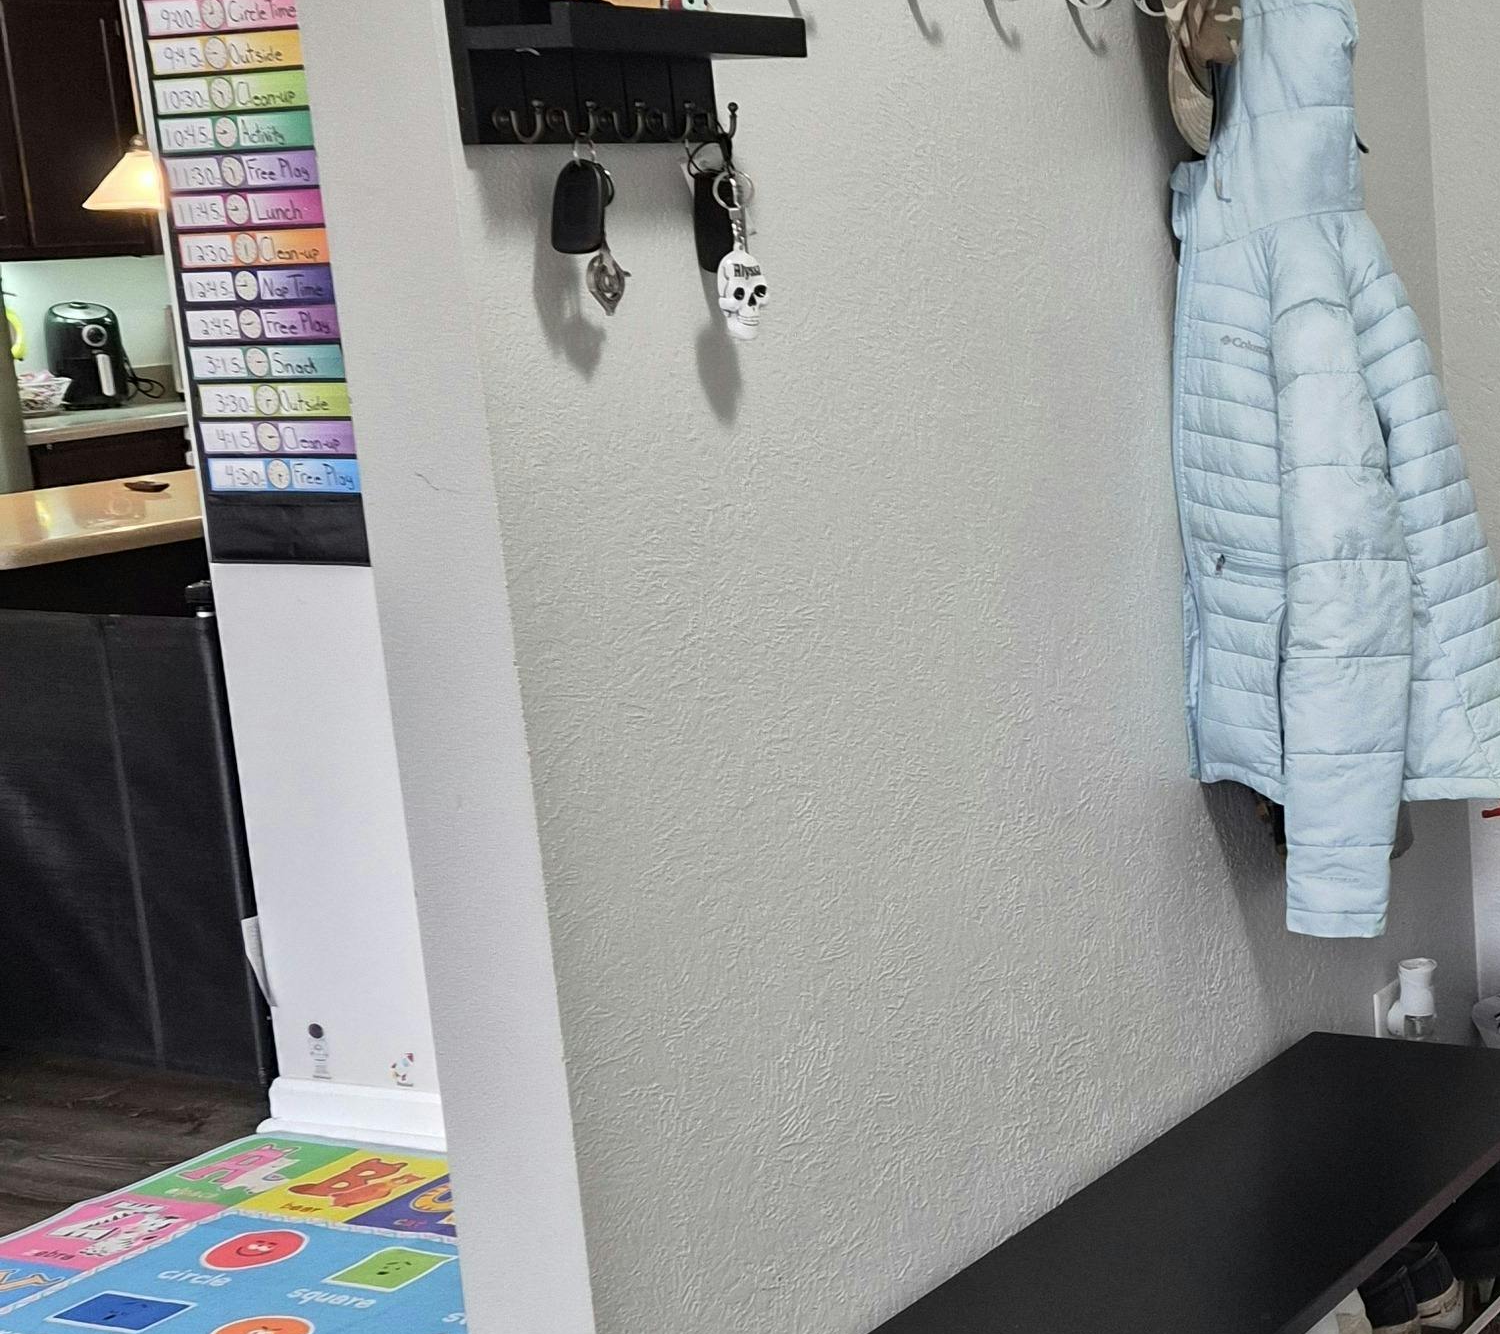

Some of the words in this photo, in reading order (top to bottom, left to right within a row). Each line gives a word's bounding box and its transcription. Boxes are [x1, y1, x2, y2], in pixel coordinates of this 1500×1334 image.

[161, 9, 195, 30] 9:00
[228, 0, 267, 22] Circle
[164, 46, 200, 67] 9:45
[229, 43, 283, 64] Outside
[247, 158, 275, 180] Free
[278, 157, 310, 181] Play
[253, 197, 303, 222] Lunch
[263, 278, 290, 299] Nap
[287, 273, 324, 296] Time
[266, 311, 298, 334] Free
[299, 310, 331, 335] Play
[273, 352, 317, 374] Snack
[279, 390, 329, 412] Outside
[292, 463, 321, 485] Free
[323, 463, 354, 489] Play
[279, 1202, 322, 1214] bear
[22, 1248, 77, 1261] zebra
[157, 1268, 233, 1288] circle
[286, 1288, 377, 1310] square
